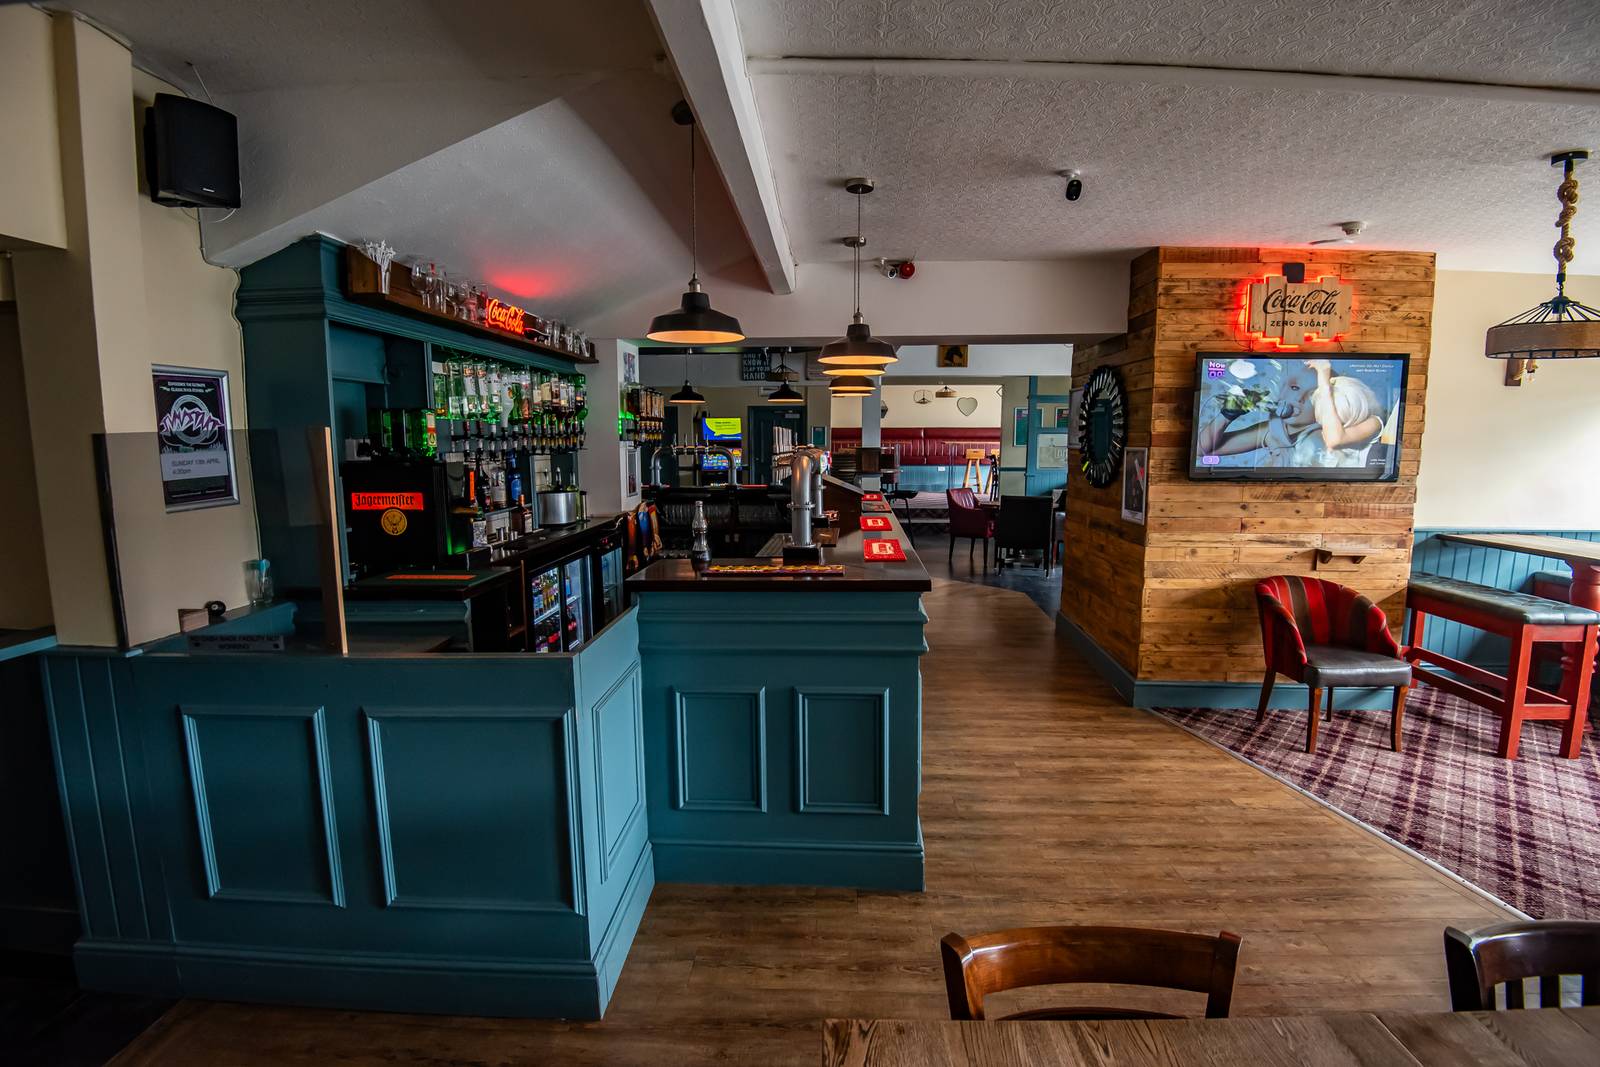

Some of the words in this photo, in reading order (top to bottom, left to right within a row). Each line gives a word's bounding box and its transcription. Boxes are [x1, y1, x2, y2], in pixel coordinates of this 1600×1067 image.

[1262, 288, 1341, 315] Coca-Cola
[1270, 320, 1296, 328] ZERO
[1298, 320, 1329, 328] SUGAR
[171, 459, 193, 467] SUNDAY
